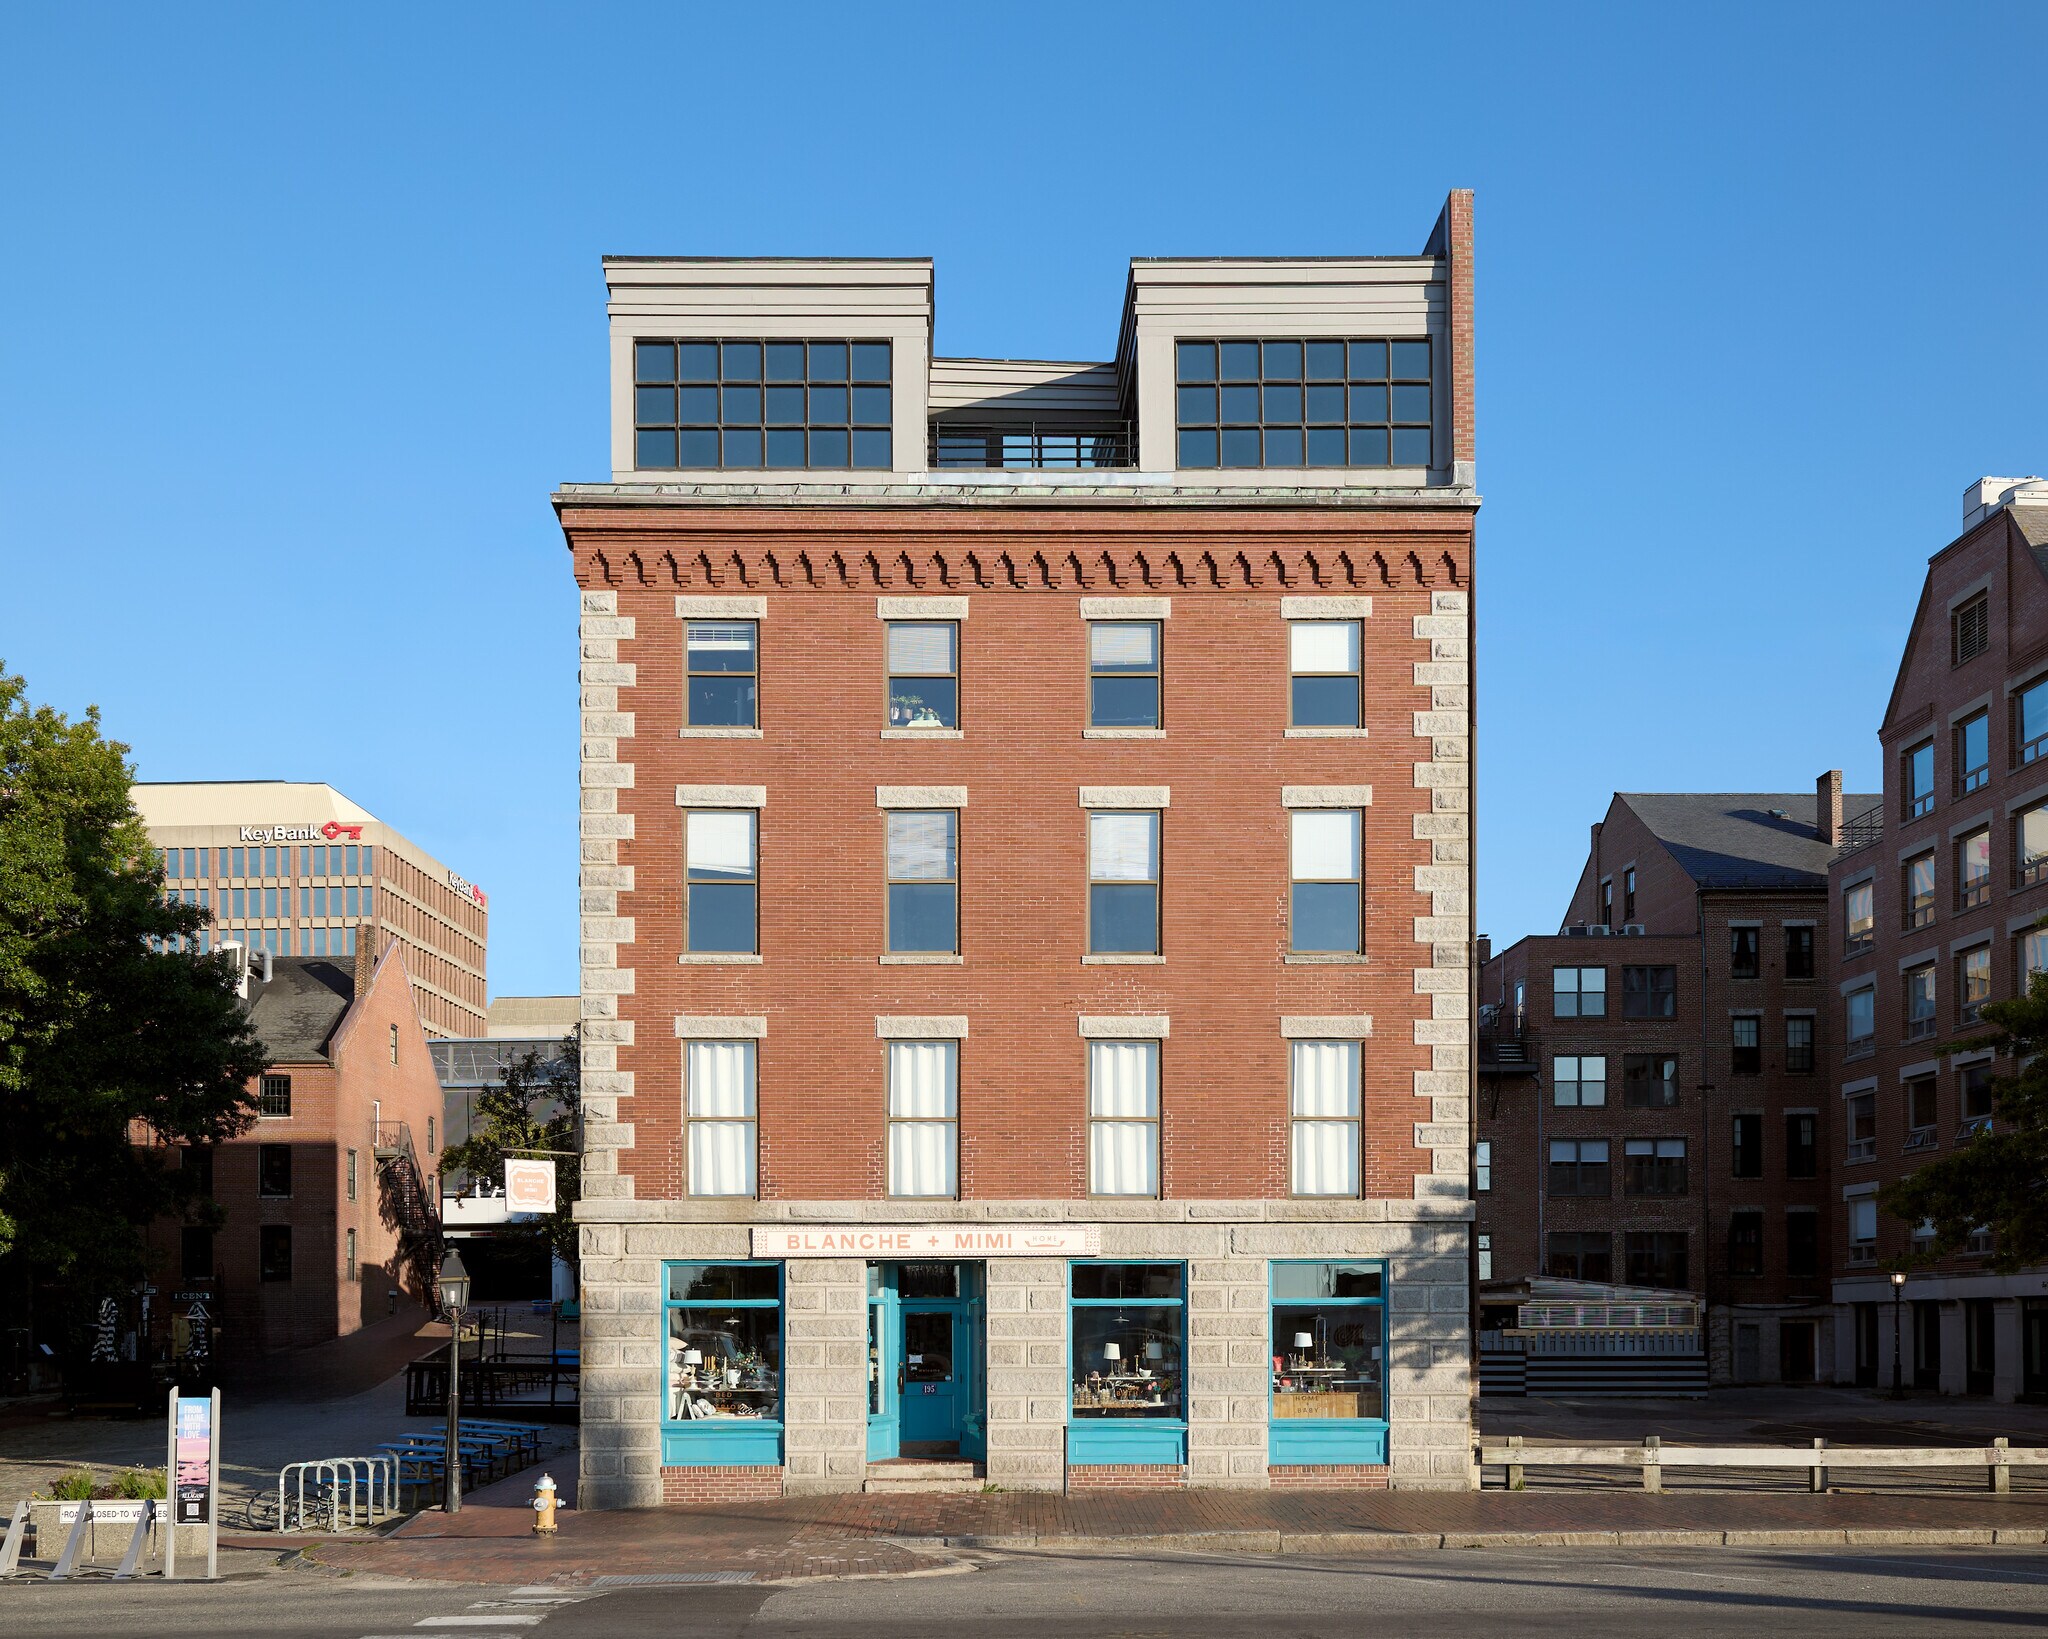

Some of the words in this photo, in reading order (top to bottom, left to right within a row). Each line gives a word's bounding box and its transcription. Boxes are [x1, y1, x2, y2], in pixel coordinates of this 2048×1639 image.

[240, 824, 320, 844] KeyBank
[448, 870, 474, 899] KeyBank
[787, 1233, 911, 1250] BLANCHE
[954, 1233, 1013, 1249] MIMI
[924, 1385, 935, 1394] 195
[184, 1405, 203, 1414] FROM
[184, 1422, 201, 1431] WITH
[63, 1510, 79, 1518] ROA
[92, 1510, 117, 1518] LOSED
[120, 1510, 130, 1518] TO
